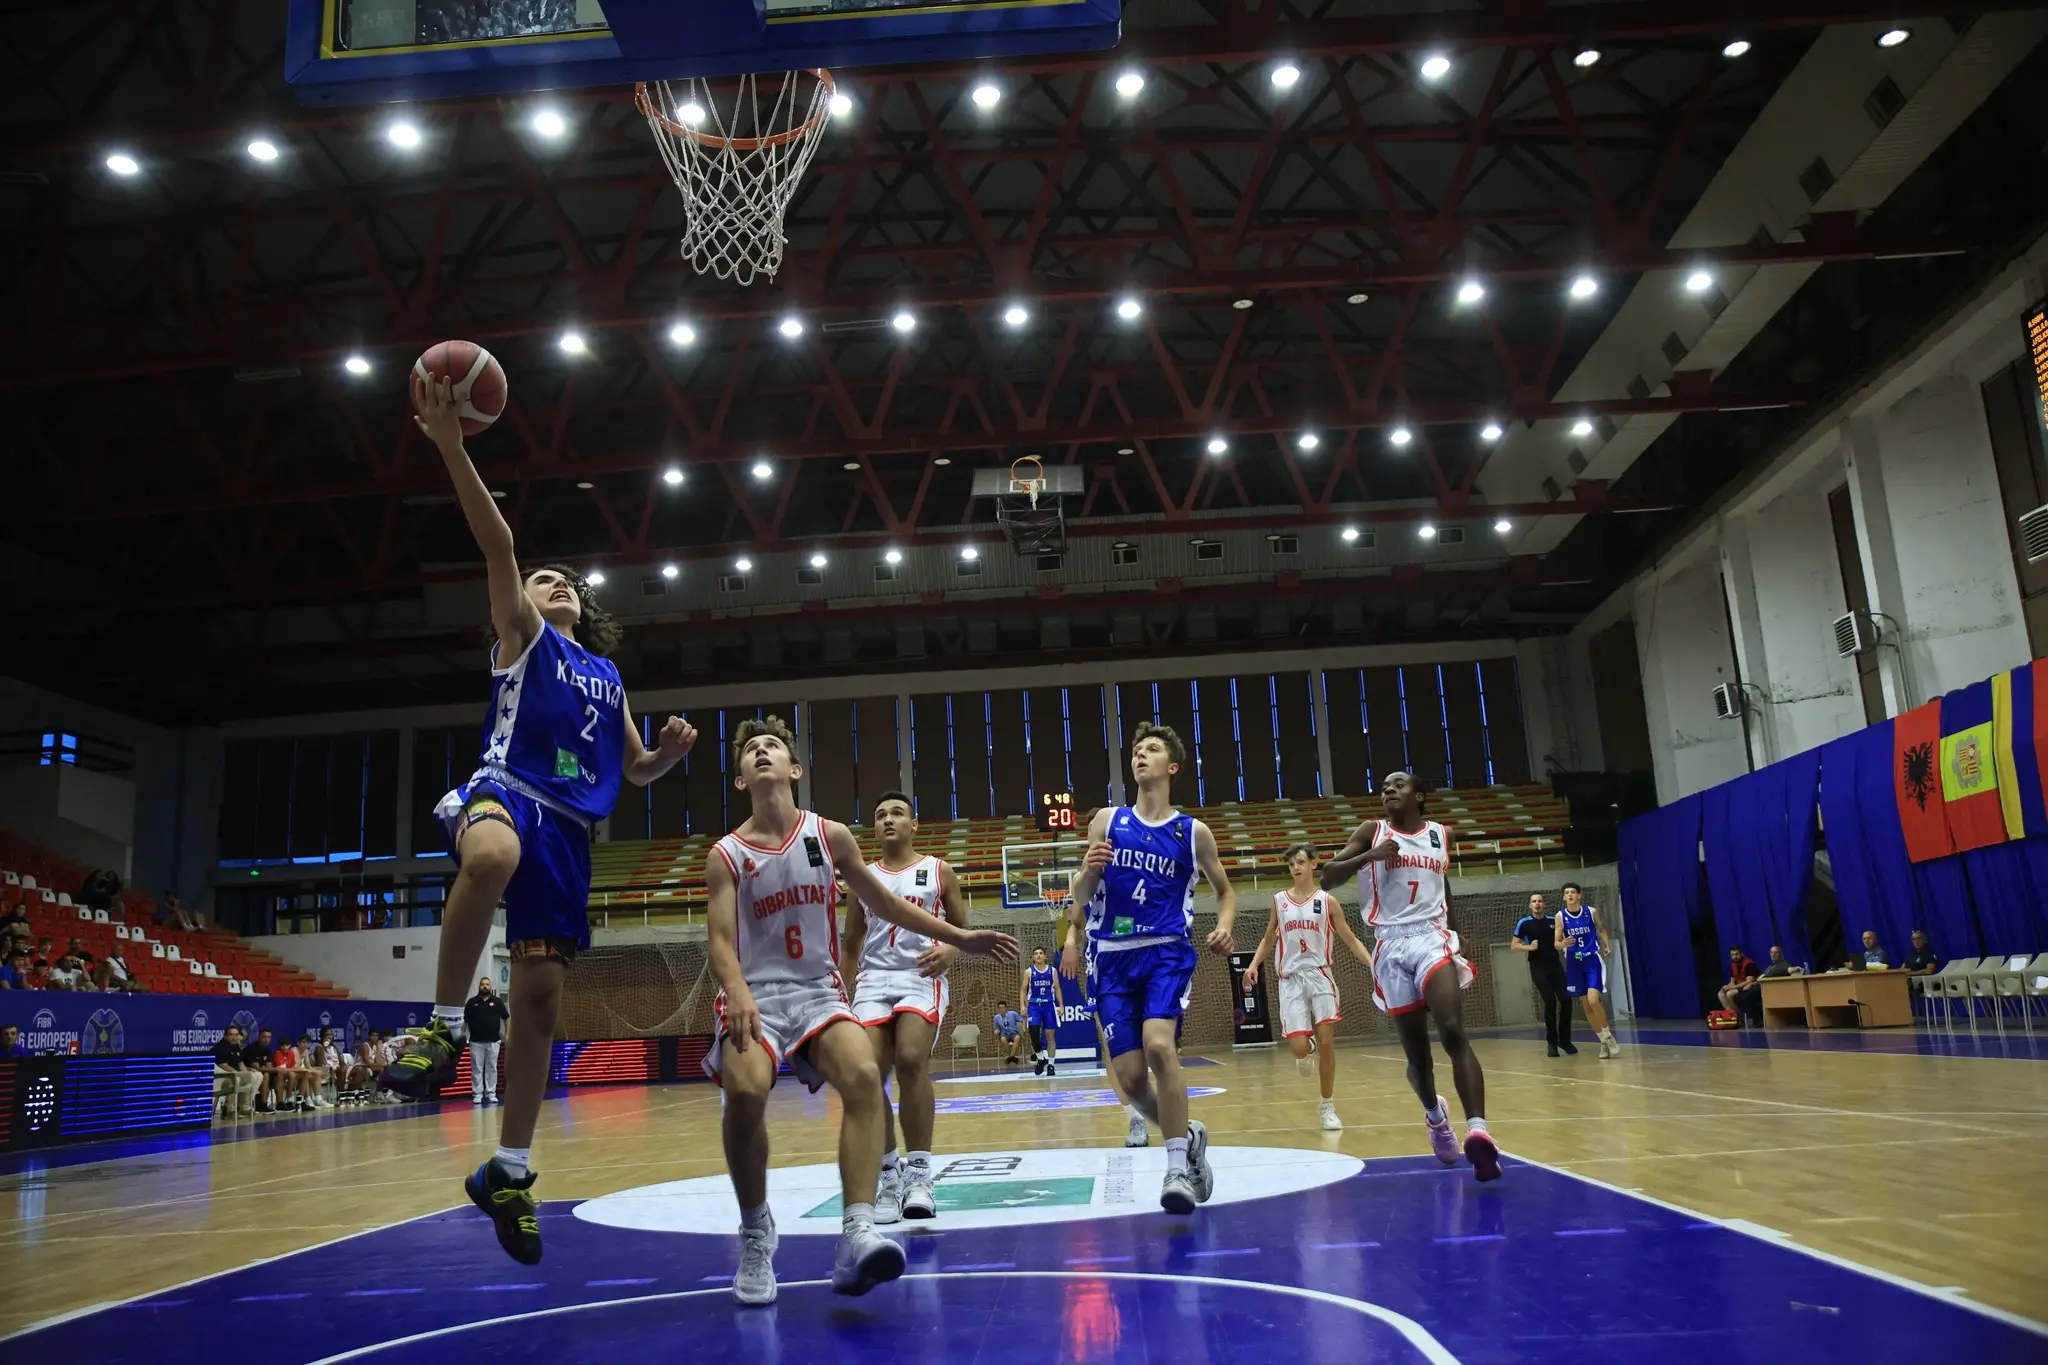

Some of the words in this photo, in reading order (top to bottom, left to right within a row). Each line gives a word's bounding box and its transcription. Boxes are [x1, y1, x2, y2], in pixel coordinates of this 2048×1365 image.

[580, 704, 599, 742] 2
[1048, 808, 1071, 826] 20
[1111, 848, 1176, 878] KOSOVA
[1131, 878, 1147, 905] 4
[1407, 881, 1420, 905] 7
[784, 924, 804, 960] 6
[1299, 938, 1308, 953] 8
[1577, 936, 1585, 948] 5
[36, 1017, 52, 1029] FIBA
[27, 1031, 78, 1049] EUROPEAN
[173, 1029, 187, 1045] U16
